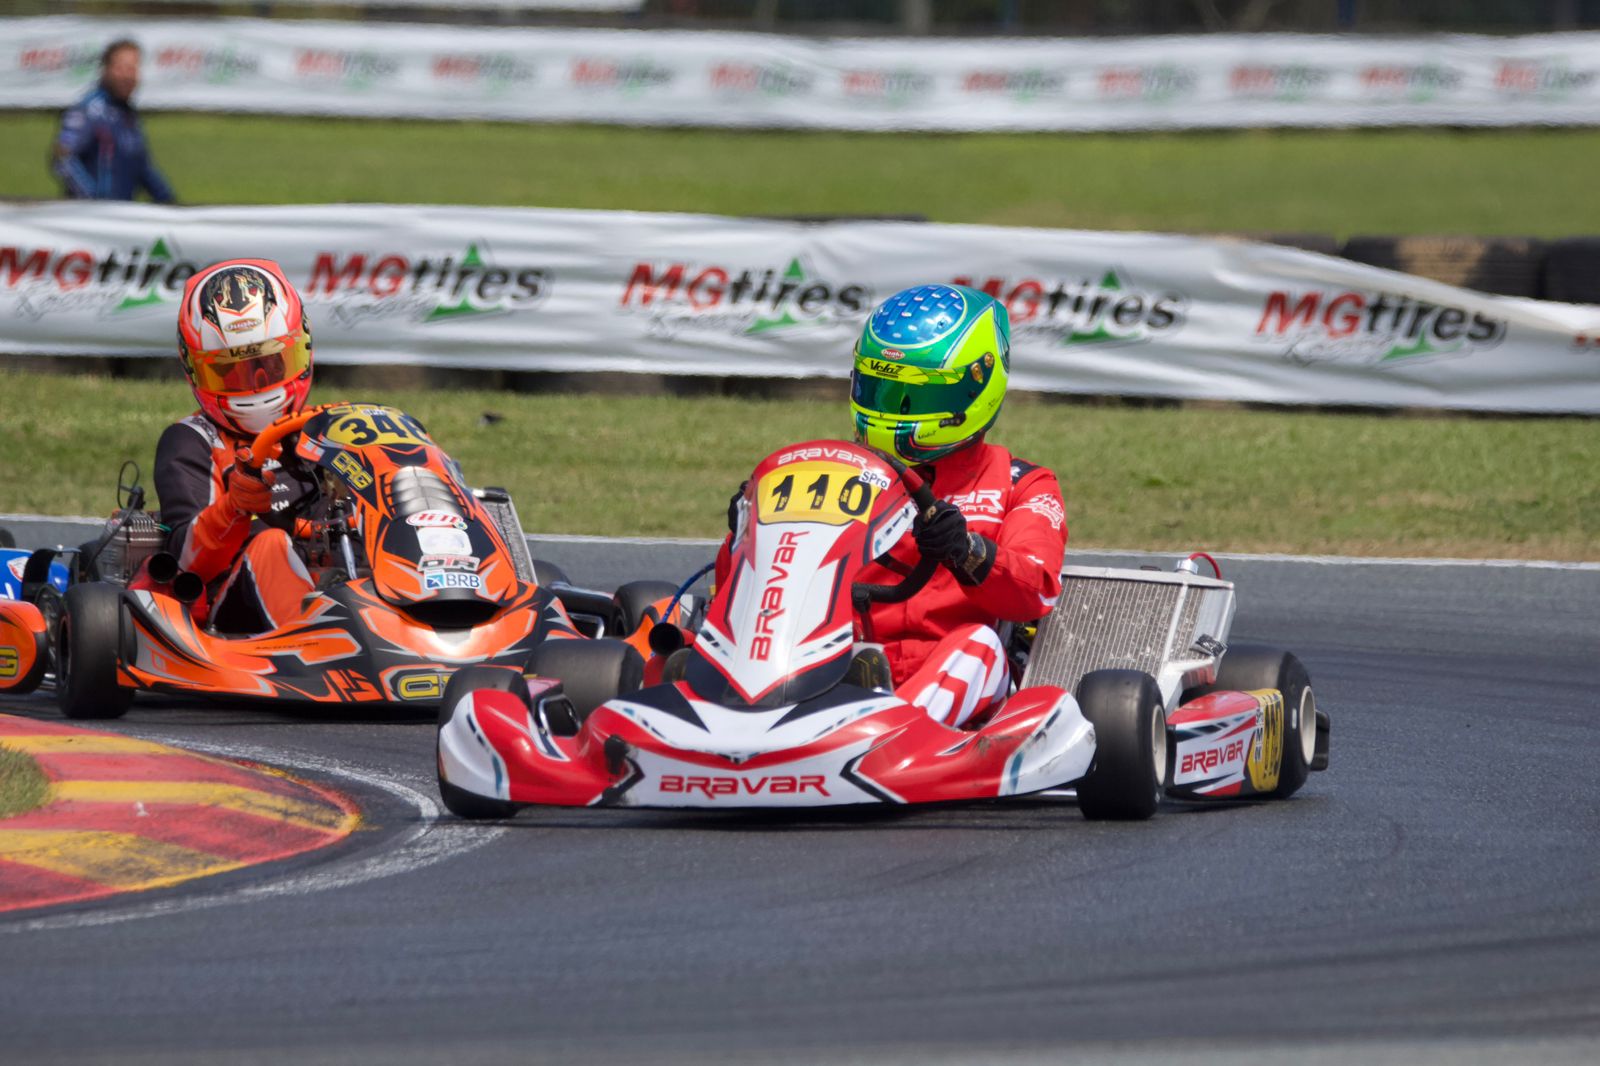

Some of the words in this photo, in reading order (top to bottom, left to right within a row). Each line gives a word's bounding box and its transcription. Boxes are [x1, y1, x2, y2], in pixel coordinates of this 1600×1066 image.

[0, 246, 197, 292] MGtire
[306, 252, 547, 301] MGtires
[620, 263, 866, 312] MGtires
[1255, 290, 1501, 343] MGtires
[331, 450, 373, 490] CRG
[861, 470, 888, 489] SPro
[772, 474, 872, 517] 110
[446, 573, 480, 588] BRB
